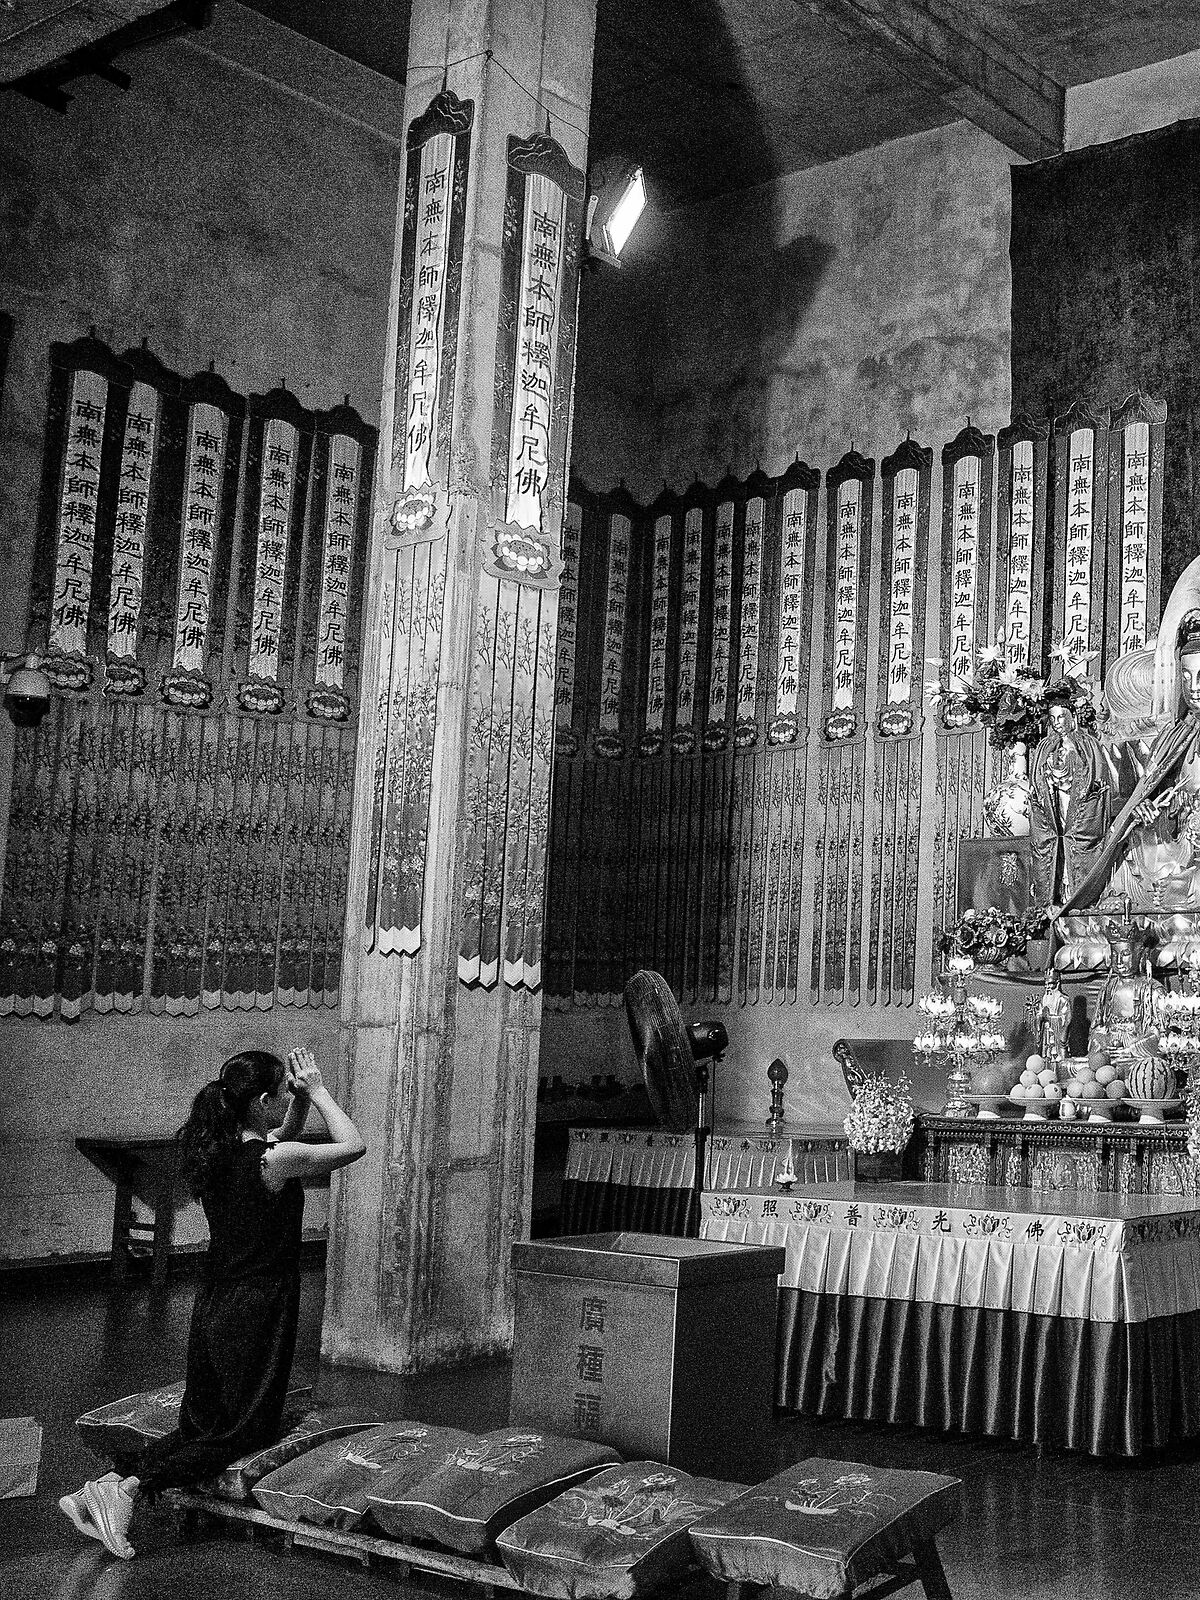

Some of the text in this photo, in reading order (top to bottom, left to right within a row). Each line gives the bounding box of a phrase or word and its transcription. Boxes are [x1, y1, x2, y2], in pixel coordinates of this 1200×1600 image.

[514, 209, 559, 497] 南無本師釋迦牟尼佛
[56, 400, 103, 630] 南無本師釋迦牟尼佛
[111, 412, 154, 634] 南無本師釋迦牟尼佛
[180, 429, 220, 648] 南無本師釋迦牟尼佛
[254, 445, 291, 657] 南無本師釋迦牟尼佛
[321, 462, 355, 667] 南無本師釋迦牟尼佛
[779, 511, 802, 696] 南無本師釋迦牟尼佛
[836, 500, 857, 689] 南無本師釋迦牟尼佛
[891, 492, 914, 684] 南無本師釋迦牟尼佛
[952, 480, 975, 677] 南無本師釋迦牟尼佛
[760, 1200, 1045, 1242] 佛 光 普 照
